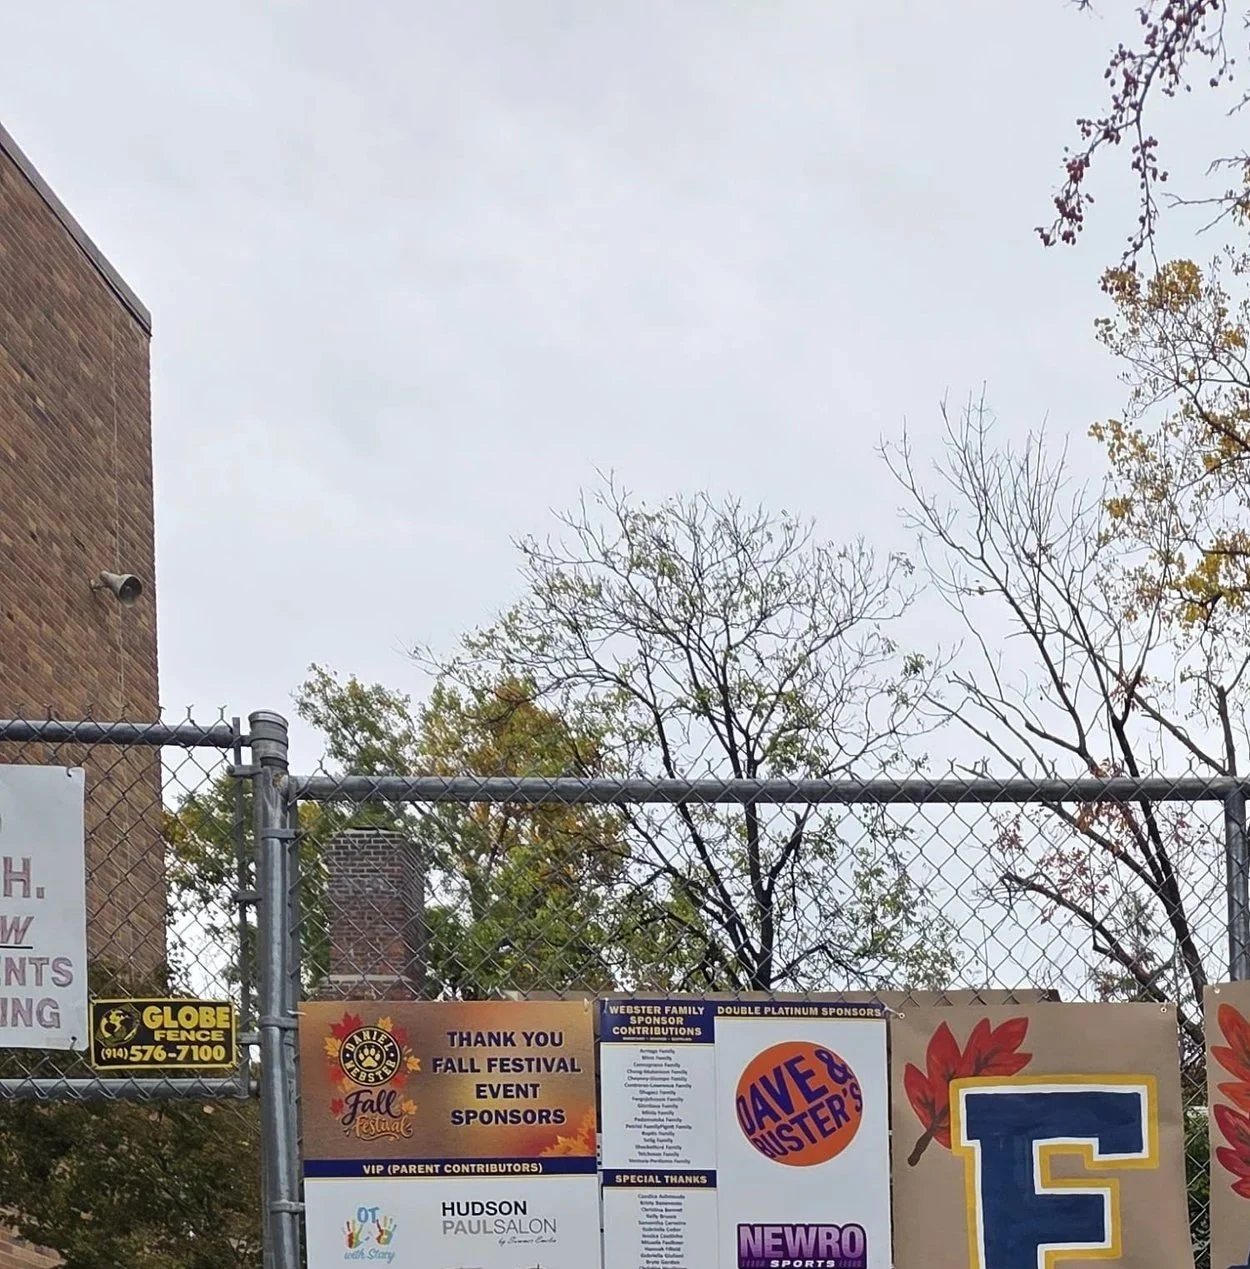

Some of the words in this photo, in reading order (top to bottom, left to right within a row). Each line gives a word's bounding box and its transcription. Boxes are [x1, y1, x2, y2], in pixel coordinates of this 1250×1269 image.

[0, 957, 73, 987] NTS
[143, 1006, 230, 1029] GLOBE
[609, 1005, 662, 1015] WEBSTER
[664, 1006, 705, 1015] FAMILY
[717, 1006, 761, 1015] DOUBLE
[764, 1006, 819, 1016] PLATINUM
[821, 1007, 881, 1017] SPONSORS
[630, 1016, 684, 1025] SPONSOR
[154, 1030, 224, 1041] FENCE
[446, 1031, 518, 1047] THANK
[522, 1031, 564, 1047] YOU
[612, 1026, 702, 1036] CONTRIBUTIONS
[345, 1031, 394, 1052] DANIEL
[345, 1060, 396, 1082] WEBSTER
[432, 1057, 481, 1073] FALL
[487, 1057, 581, 1073] FESTIVAL
[475, 1083, 541, 1099] EVENT
[736, 1055, 829, 1137] DAVE
[814, 1048, 854, 1085] &
[342, 1089, 402, 1125] Fall
[451, 1109, 566, 1125] SPONSORS
[751, 1082, 863, 1159] BUSTER'S
[353, 1115, 413, 1141] Festival
[363, 1165, 384, 1174] VIP
[387, 1164, 440, 1175] (PARENT
[444, 1163, 543, 1174] CONTRIBUTORS)
[615, 1174, 661, 1184] SPECIAL
[664, 1174, 708, 1184] THANKS
[442, 1201, 527, 1216] HUDSON
[442, 1218, 557, 1235] PAULSALON
[738, 1226, 864, 1259] NEWRO
[769, 1260, 836, 1268] SPORTS
